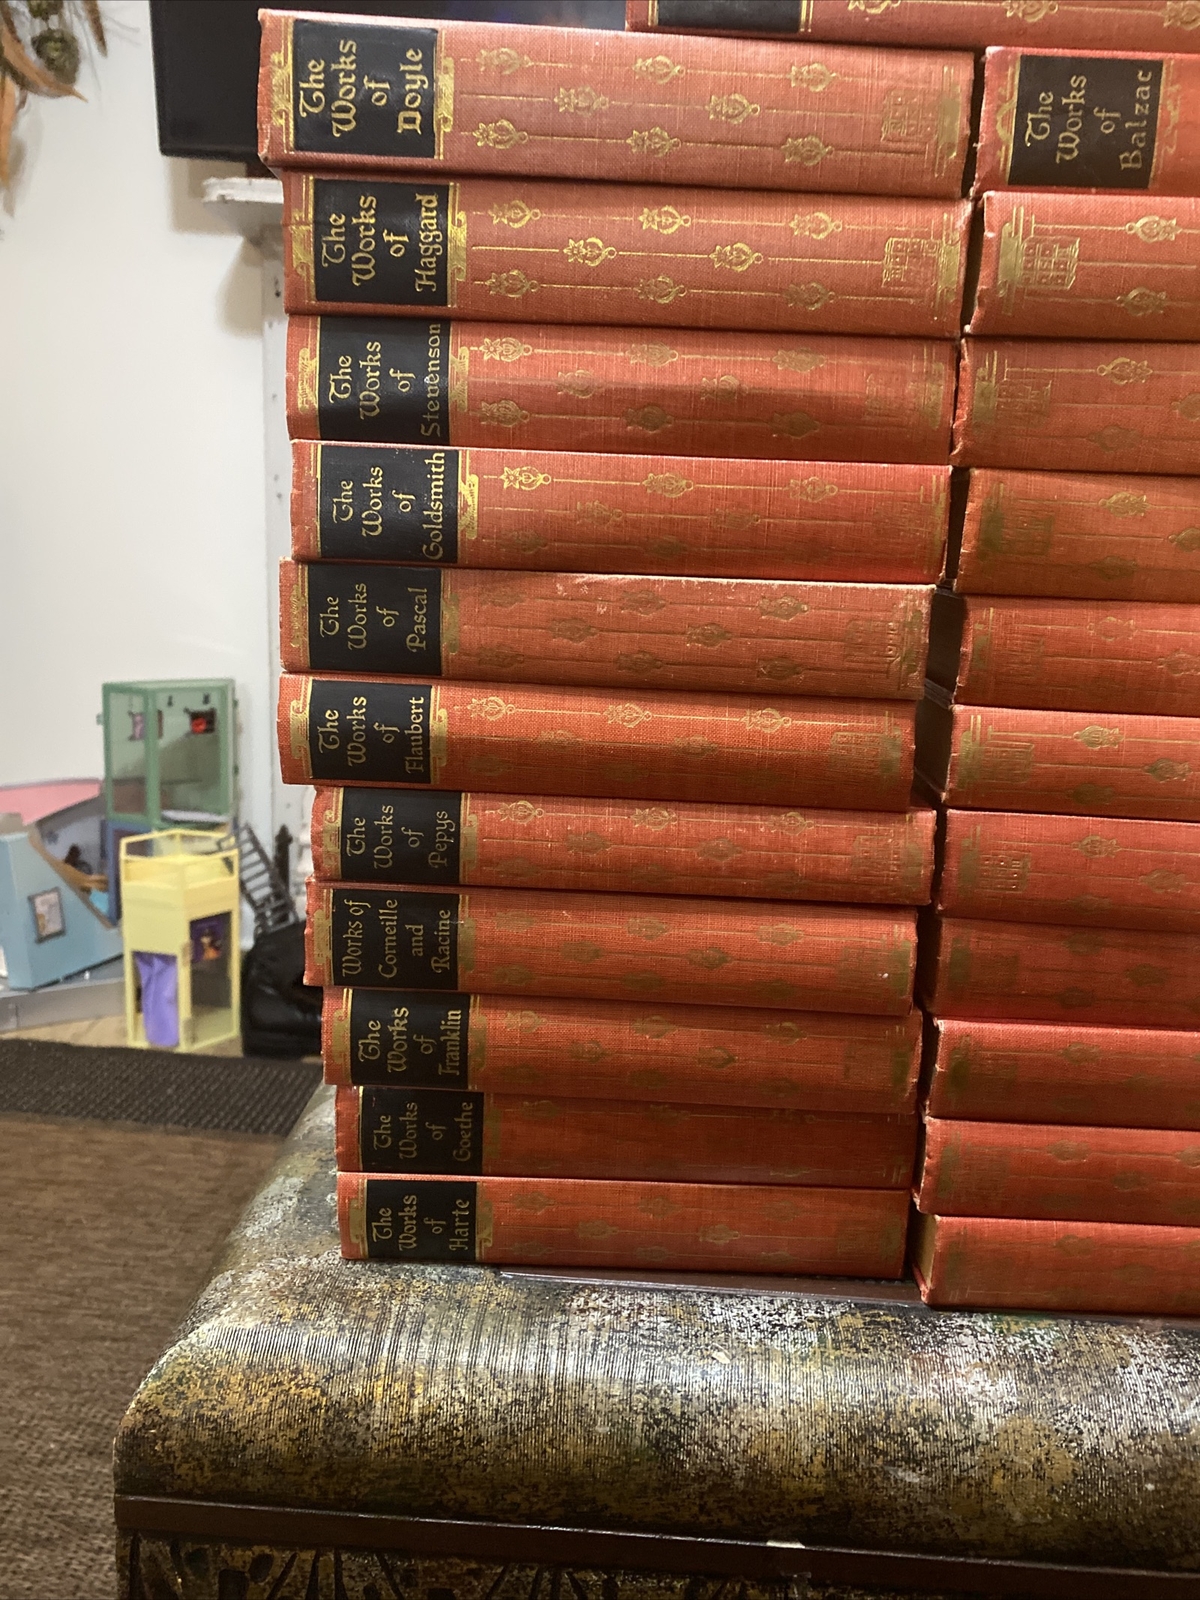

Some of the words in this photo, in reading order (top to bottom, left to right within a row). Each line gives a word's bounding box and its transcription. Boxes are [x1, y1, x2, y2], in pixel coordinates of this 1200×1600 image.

[299, 59, 325, 117] The
[331, 40, 357, 138] Works
[364, 75, 391, 106] of
[397, 48, 428, 135] Doyle
[1025, 92, 1053, 147] The
[1056, 75, 1087, 164] Works
[1093, 106, 1121, 134] of
[1119, 70, 1152, 170] Balzac
[322, 213, 346, 268] The
[351, 195, 377, 286] Works
[383, 229, 409, 257] of
[414, 192, 442, 292] Haggard
[329, 355, 352, 403] The
[359, 341, 381, 420] Works
[389, 368, 416, 392] of
[332, 480, 353, 523] The
[361, 466, 383, 537] Works
[392, 490, 416, 512] of
[422, 452, 445, 560] Goldsmith
[320, 596, 339, 637] The
[347, 583, 367, 650] Works
[376, 606, 399, 627] of
[406, 587, 428, 652] Pascal
[317, 709, 340, 753] The
[346, 696, 367, 767] Works
[373, 722, 400, 743] of
[405, 696, 424, 774] Flaubert
[346, 817, 366, 856] The
[374, 805, 394, 869] Works
[401, 827, 424, 848] of
[428, 810, 455, 868] Pepys
[344, 899, 371, 916] of
[342, 920, 363, 977] Works
[378, 899, 398, 978] Corneille
[405, 924, 424, 956] and
[431, 909, 451, 973] Racine
[358, 1020, 381, 1062] The
[387, 1007, 409, 1073] Works
[413, 1034, 437, 1054] of
[438, 1009, 461, 1075] Franklin
[373, 1115, 392, 1150] The
[399, 1102, 417, 1159] Works
[425, 1122, 446, 1141] of
[453, 1102, 473, 1162] Goethe
[372, 1207, 392, 1242] The
[398, 1195, 417, 1251] Works
[424, 1217, 446, 1234] of
[449, 1199, 470, 1251] Harte
